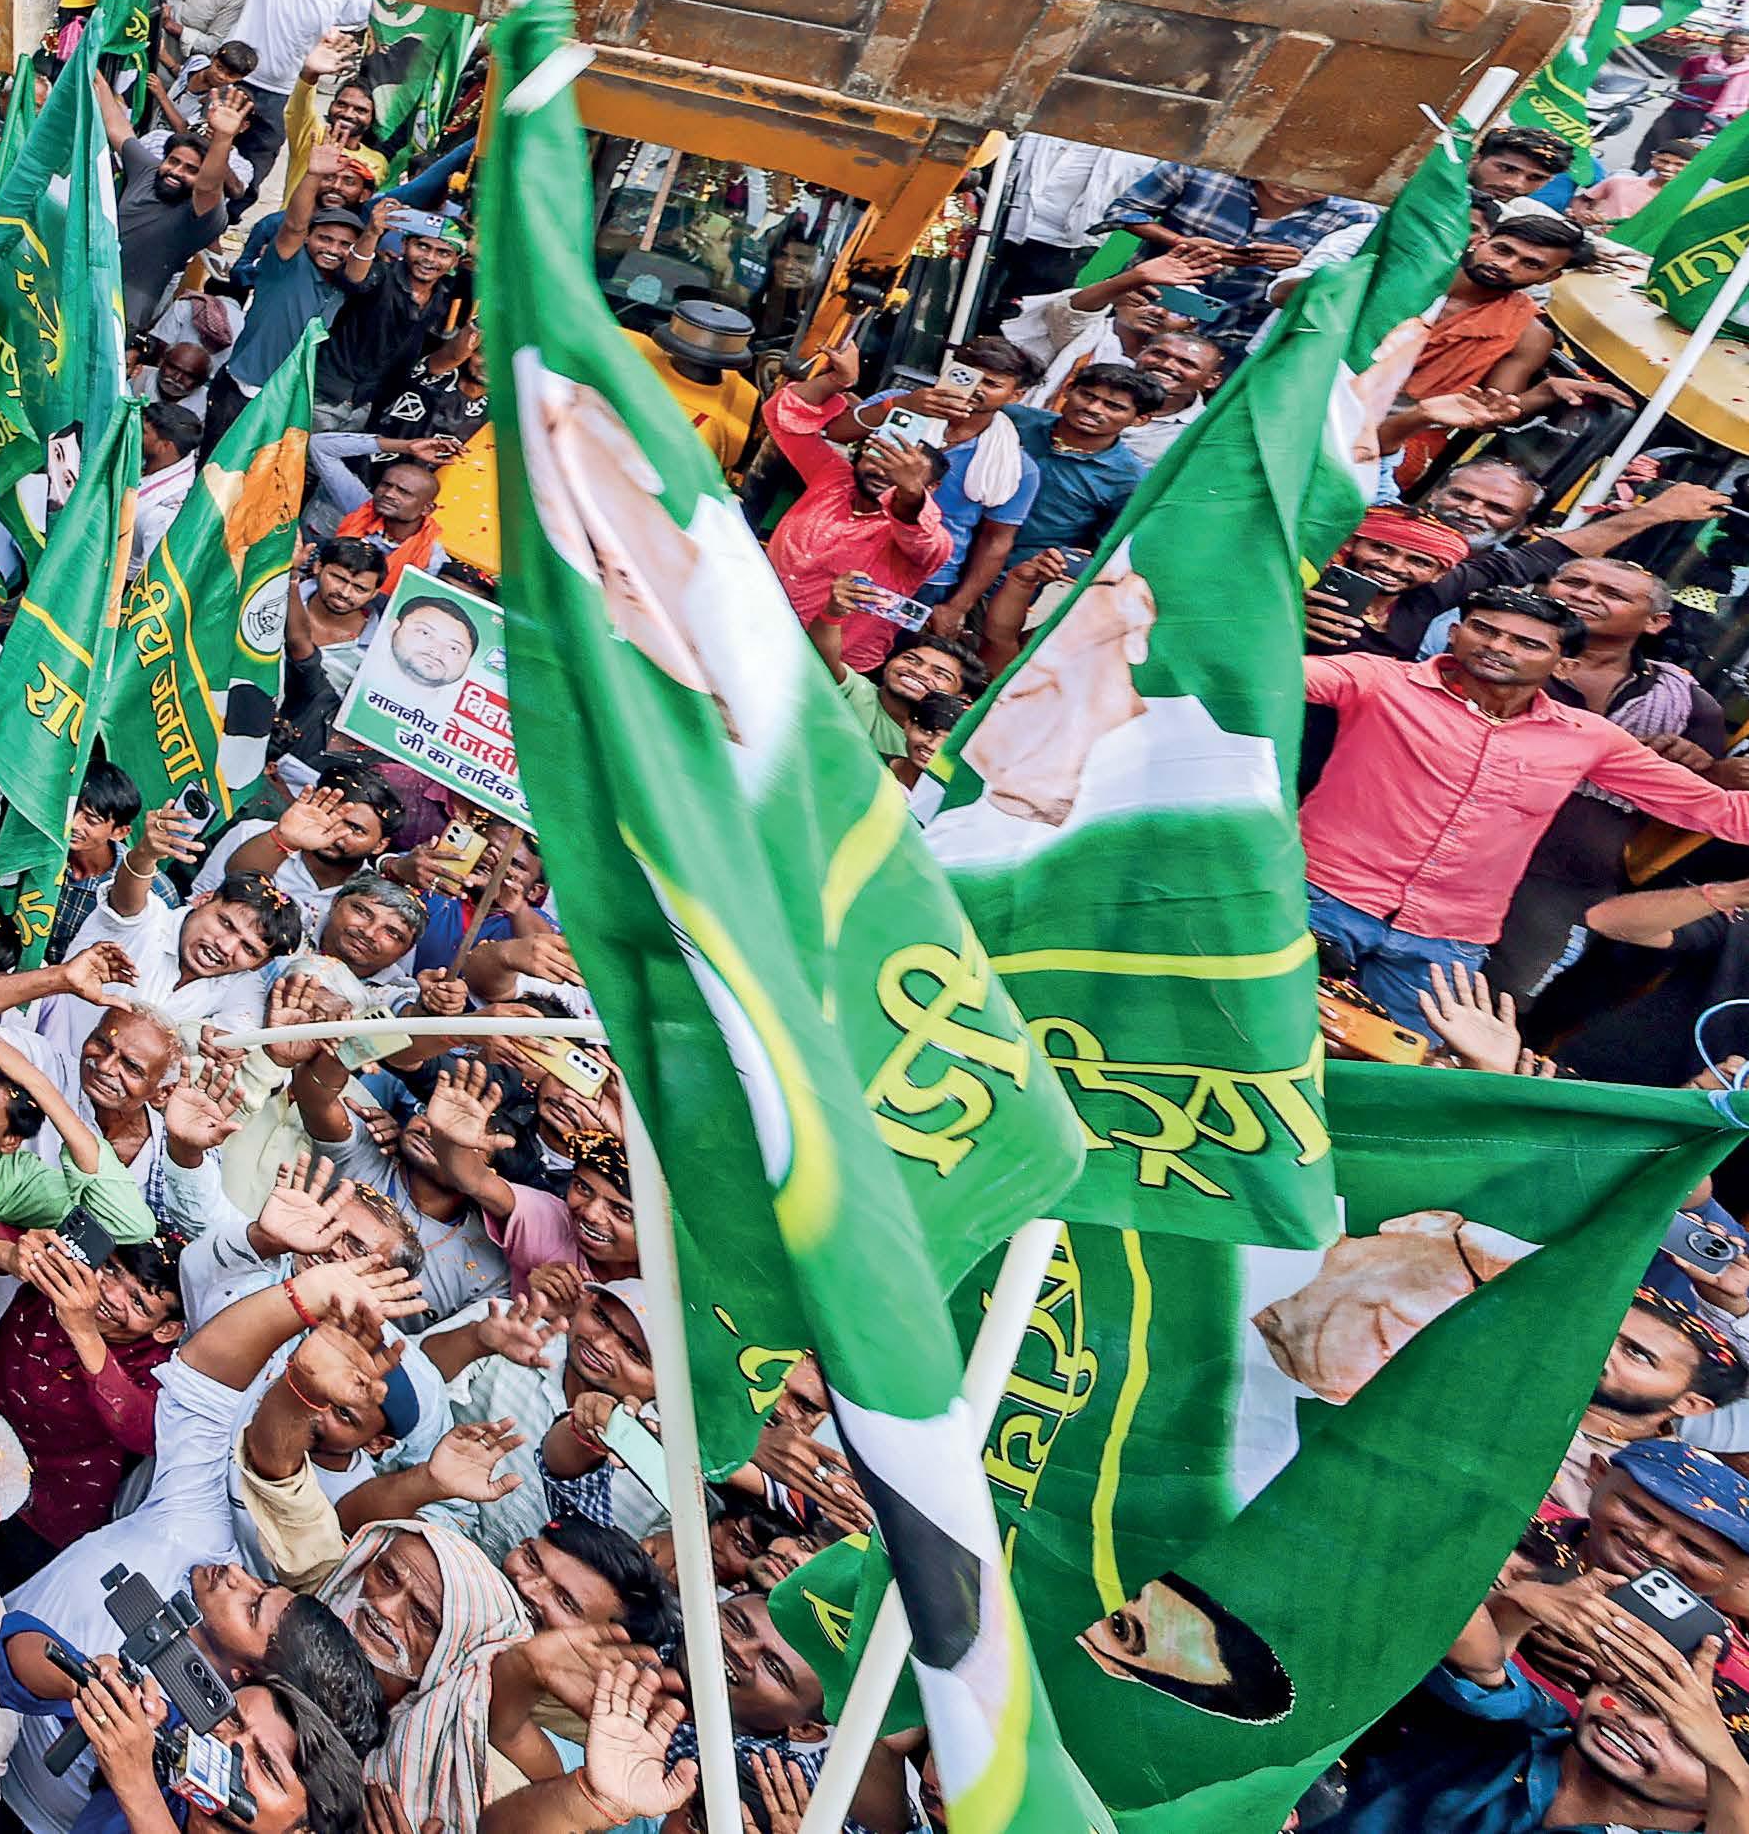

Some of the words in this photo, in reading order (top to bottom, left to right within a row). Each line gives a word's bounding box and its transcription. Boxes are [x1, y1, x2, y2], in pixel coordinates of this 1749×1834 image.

[151, 660, 206, 784] जनता
[368, 690, 438, 736] माननीय
[398, 730, 424, 754] जी
[428, 748, 455, 770] का
[456, 764, 519, 802] हार्दिक
